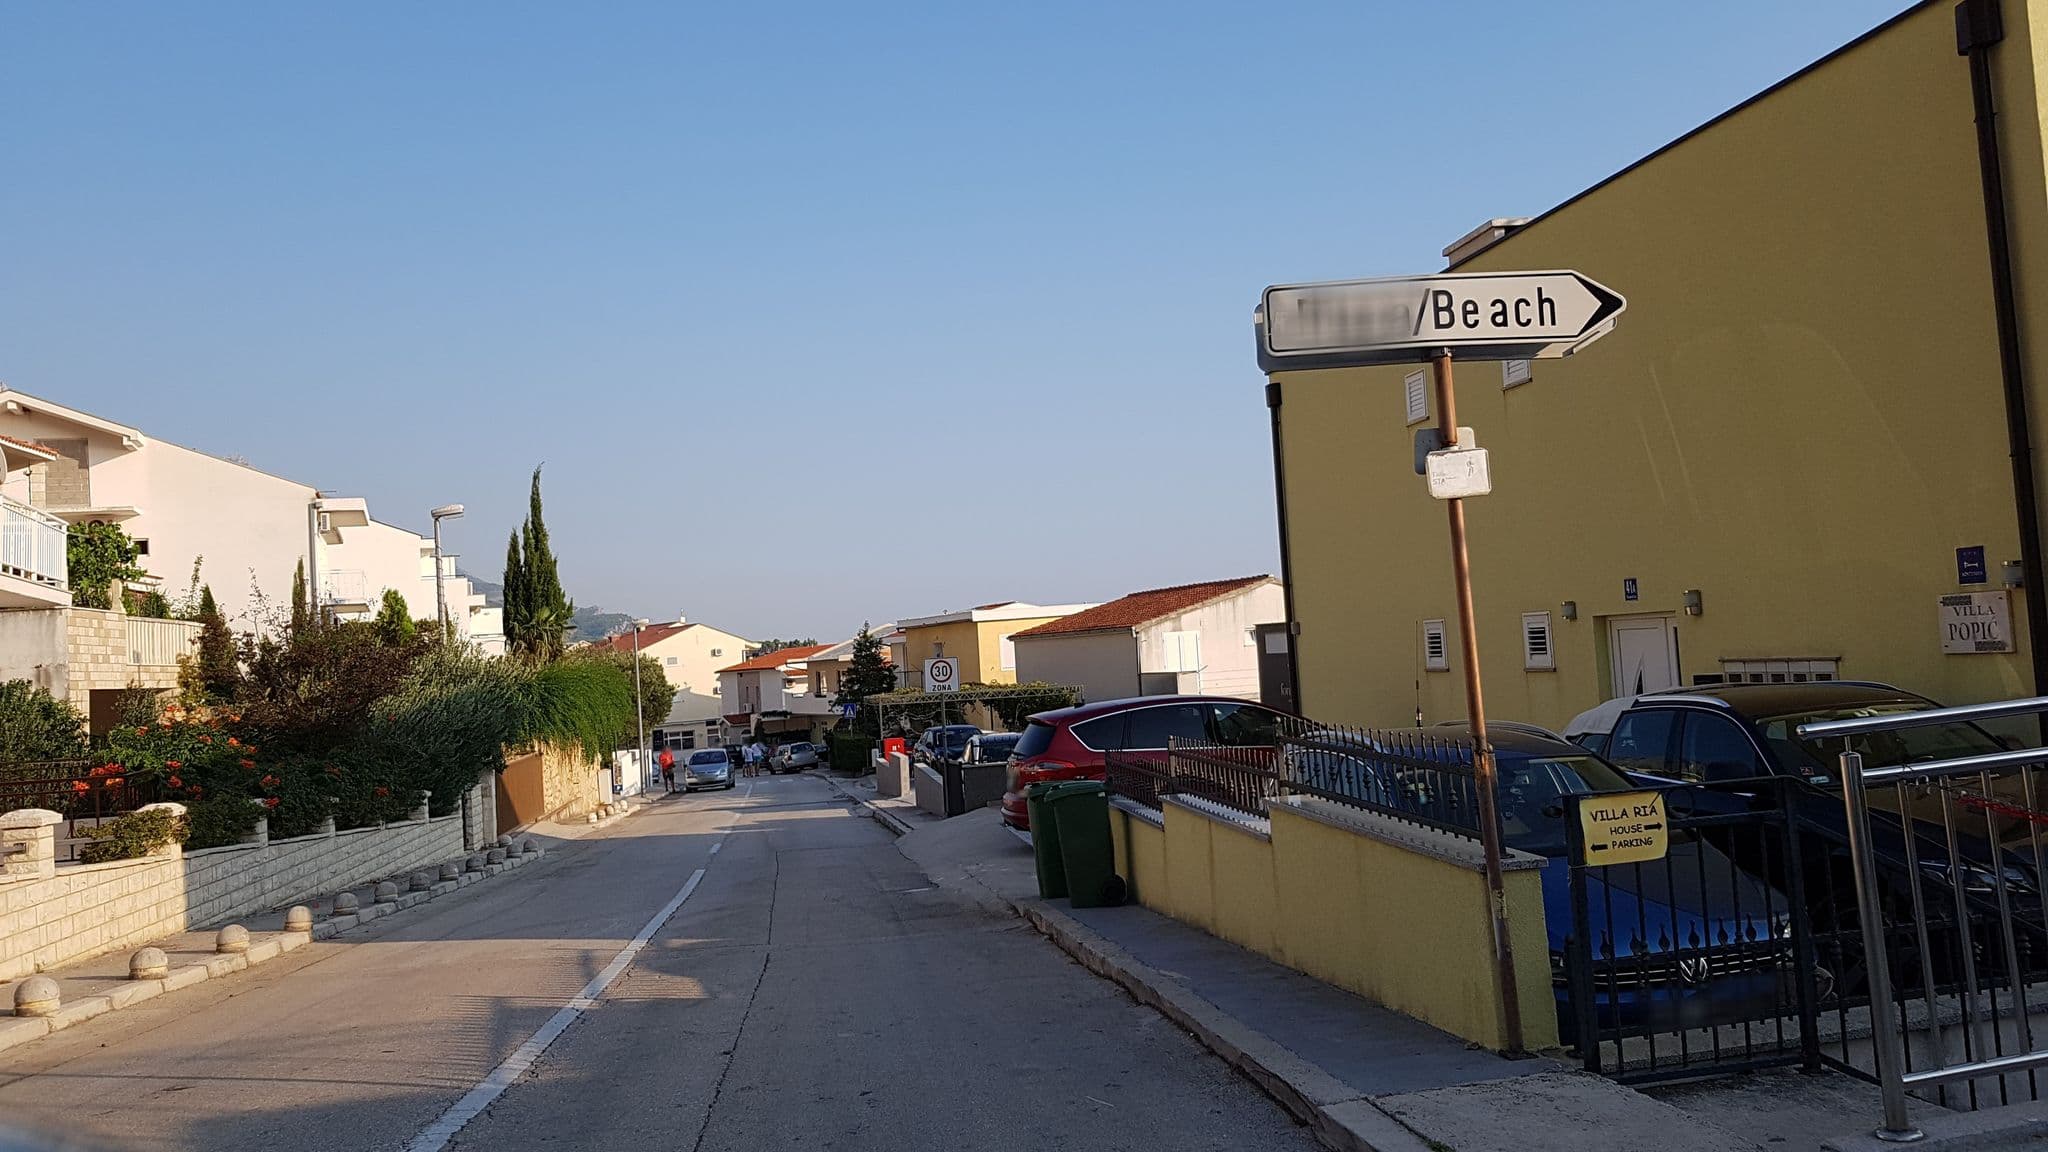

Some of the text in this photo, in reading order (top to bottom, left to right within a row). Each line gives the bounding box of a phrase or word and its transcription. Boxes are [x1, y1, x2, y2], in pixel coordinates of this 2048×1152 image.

[1953, 605, 1996, 617] VILLA
[934, 665, 948, 678] 30
[931, 684, 952, 692] ZONA
[1590, 807, 1629, 822] VILLA
[1609, 823, 1643, 836] HOUSE
[1611, 836, 1654, 849] PARKING
